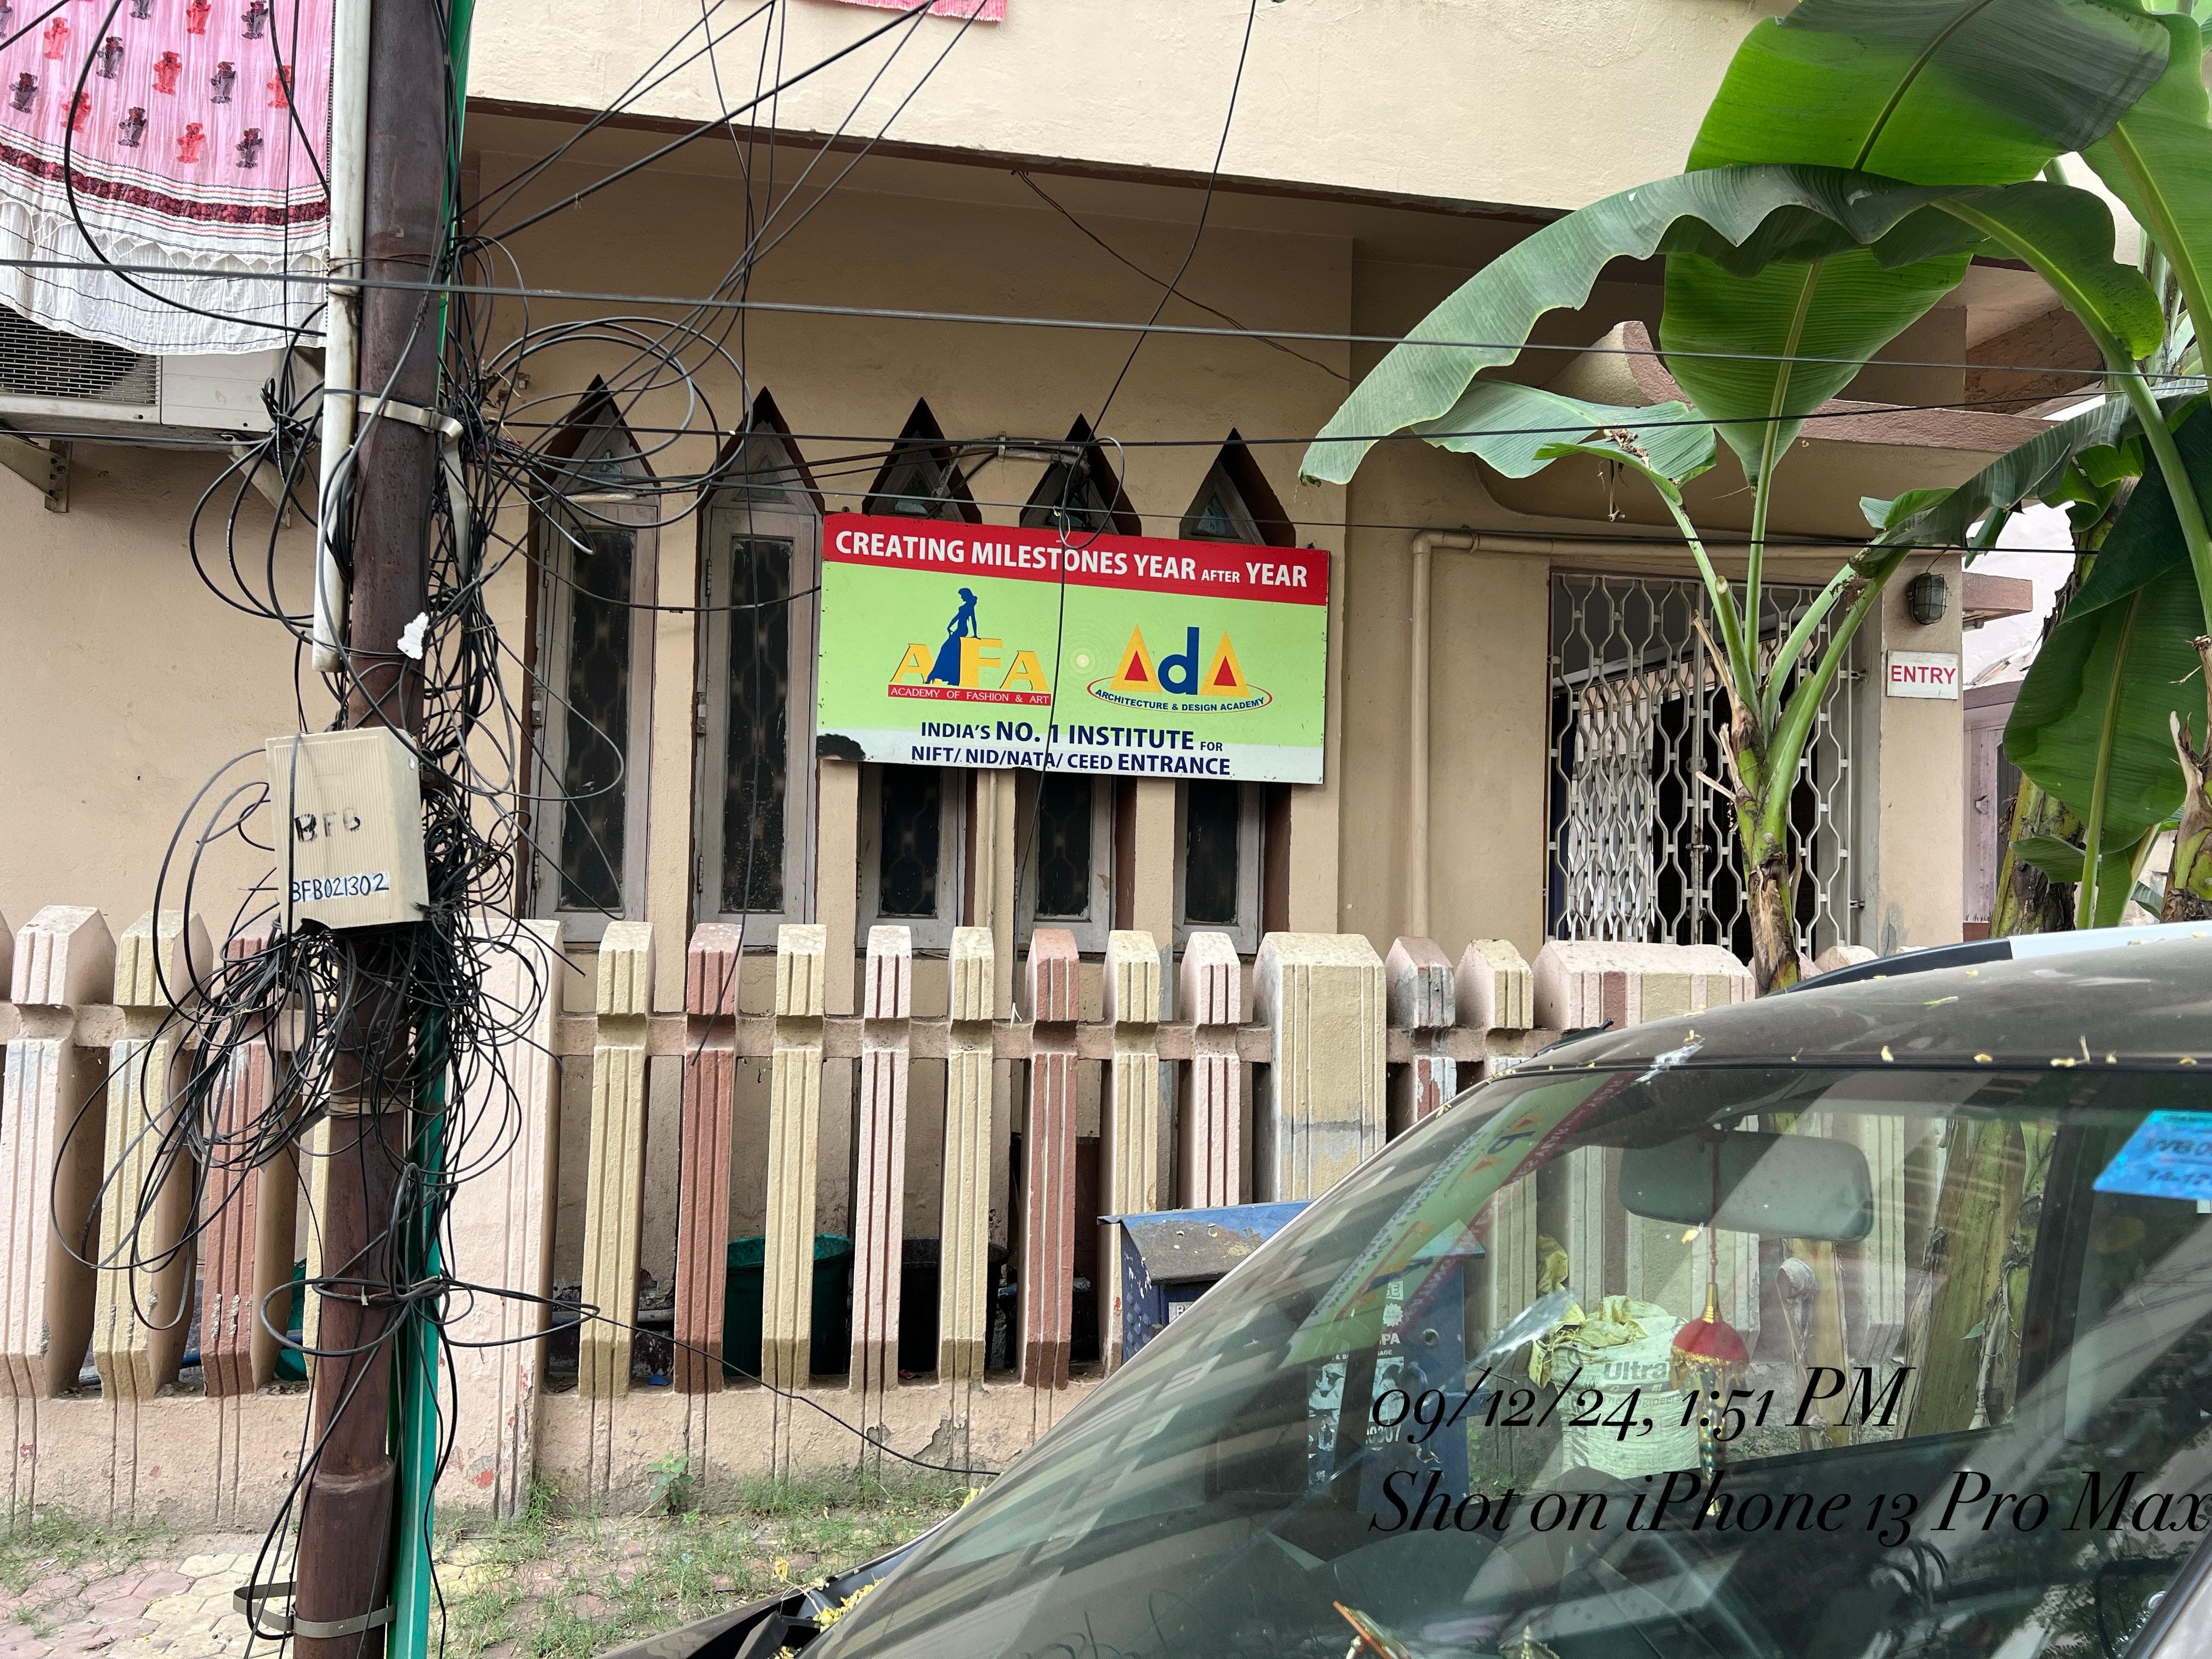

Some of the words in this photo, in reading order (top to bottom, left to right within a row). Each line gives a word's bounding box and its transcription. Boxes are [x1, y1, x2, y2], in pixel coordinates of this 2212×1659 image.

[836, 531, 964, 563] CREATING
[971, 541, 1127, 575] MILESTONES
[1133, 554, 1196, 580] YEAR
[1201, 568, 1240, 583] AFTER
[1246, 562, 1307, 588] YEAR
[890, 636, 1051, 692] AFA
[1891, 665, 1956, 684] ENTRY
[890, 687, 940, 698] ACADEMY
[946, 690, 961, 699] OF
[966, 691, 1009, 702] FASHION
[1015, 694, 1023, 703] &
[1029, 695, 1049, 704] ART
[1095, 689, 1169, 710] ARCHITECTURE
[1182, 703, 1217, 712] DESIGN
[1220, 697, 1265, 711] ACADEMY
[996, 721, 1041, 742] NO.
[1049, 724, 1059, 743] 1
[1069, 725, 1194, 751] INSTITUTE
[1200, 741, 1223, 752] FOR
[911, 746, 961, 763] NIFT/
[1067, 753, 1113, 770] CEED
[1118, 753, 1231, 775] ENTRANCE
[292, 873, 390, 903] BFB021302
